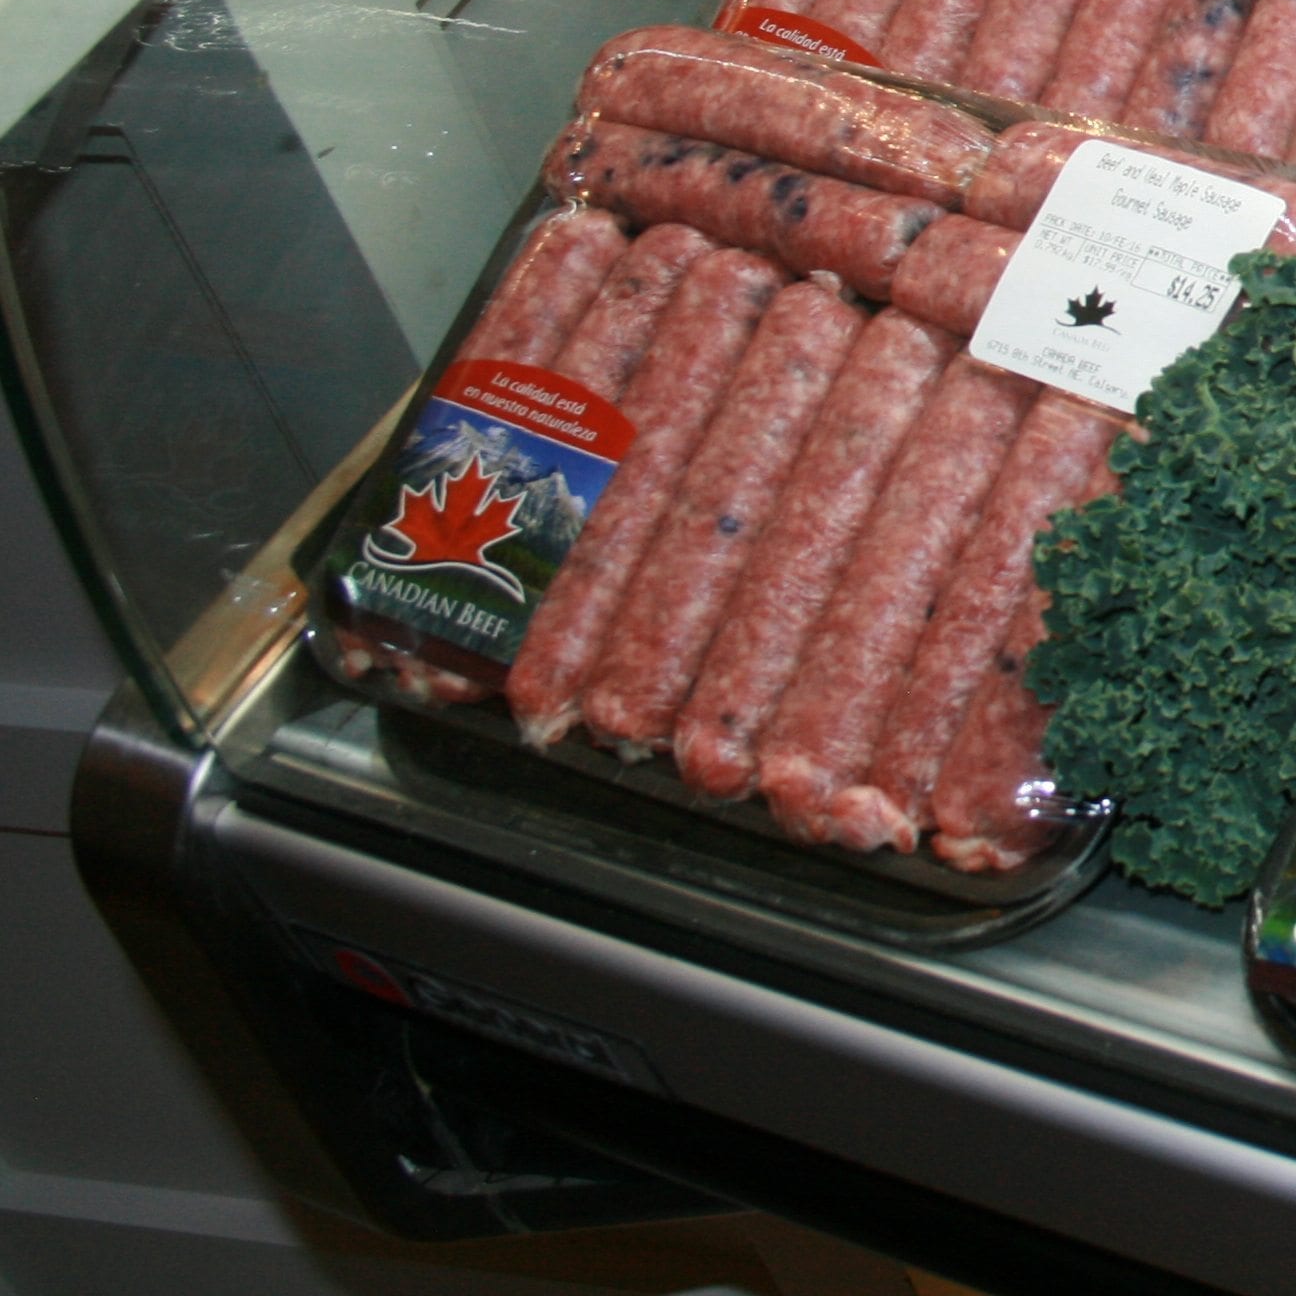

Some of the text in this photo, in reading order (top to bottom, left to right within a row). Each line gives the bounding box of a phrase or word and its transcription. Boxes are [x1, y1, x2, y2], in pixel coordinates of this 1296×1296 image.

[759, 19, 847, 61] La calidad está
[1167, 274, 1220, 310] $14.25
[463, 385, 597, 442] en nuestra naturaleza
[491, 372, 588, 415] La calidad está
[350, 562, 509, 639] CANADIAN BEEF
